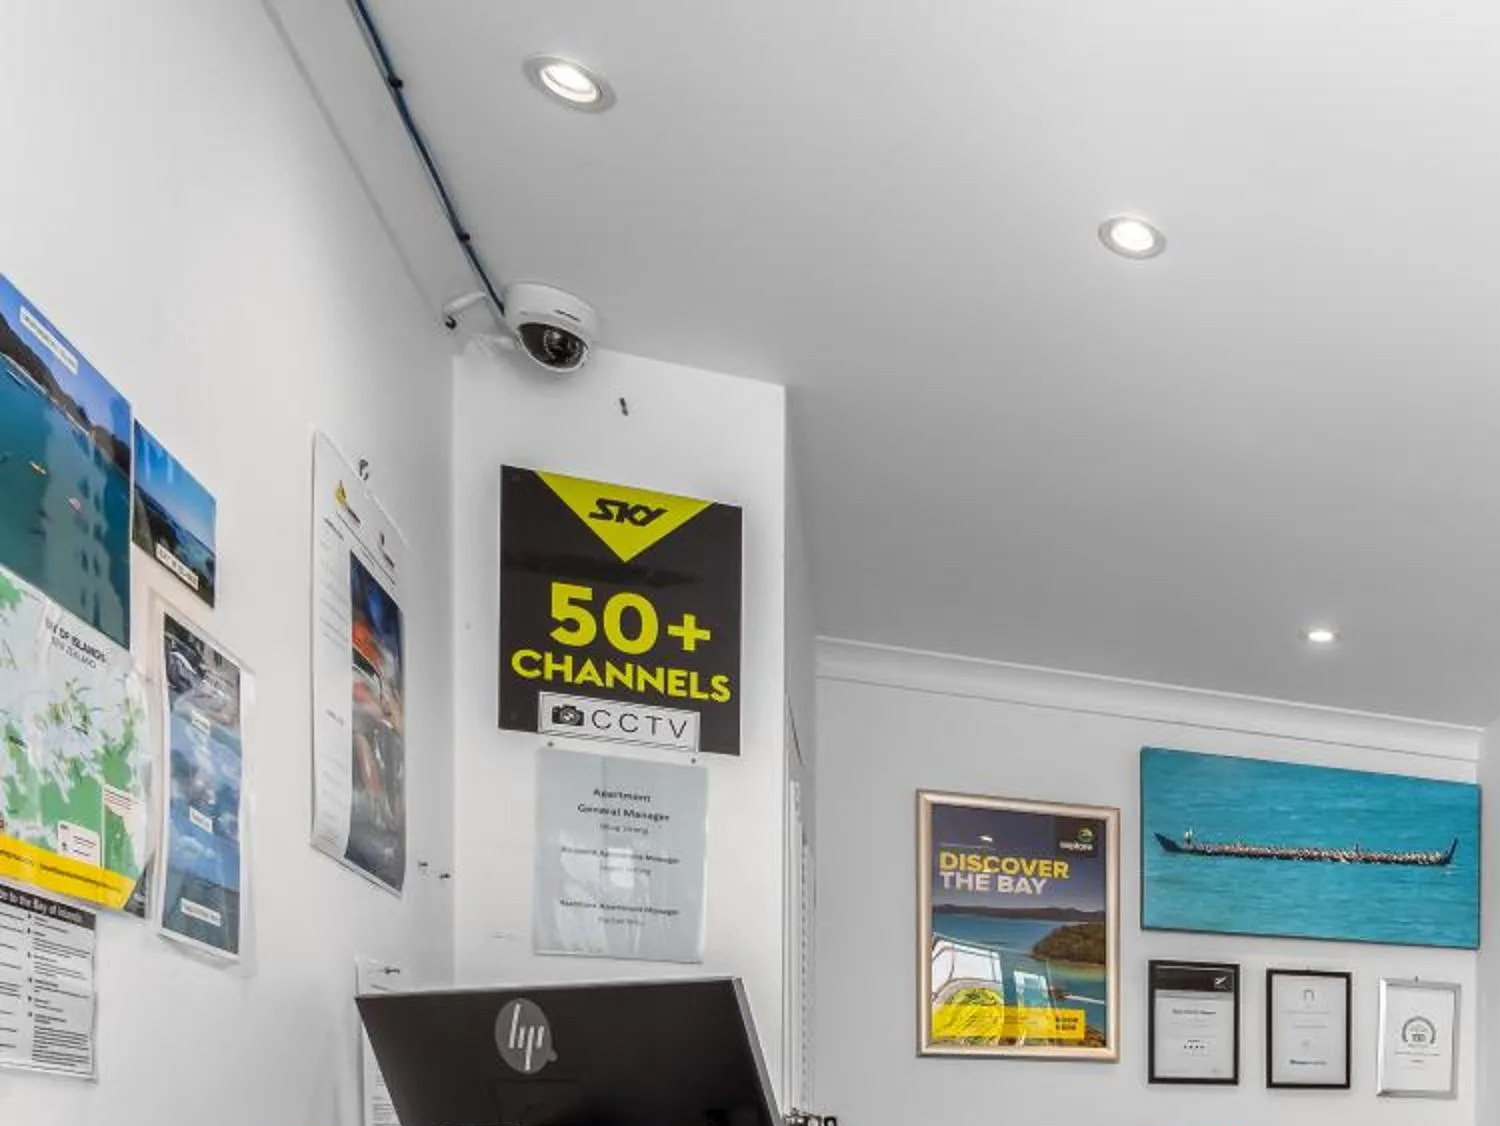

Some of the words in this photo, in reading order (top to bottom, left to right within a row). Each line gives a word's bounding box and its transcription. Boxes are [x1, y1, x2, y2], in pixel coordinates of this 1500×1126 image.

[588, 497, 668, 527] SKY
[550, 581, 711, 655] 50+
[511, 649, 731, 703] CHANNELS
[591, 707, 688, 740] CCTV
[939, 850, 1070, 879] DISCOVER
[939, 871, 989, 892] THE
[997, 875, 1047, 895] BAY
[508, 1003, 545, 1071] hp
